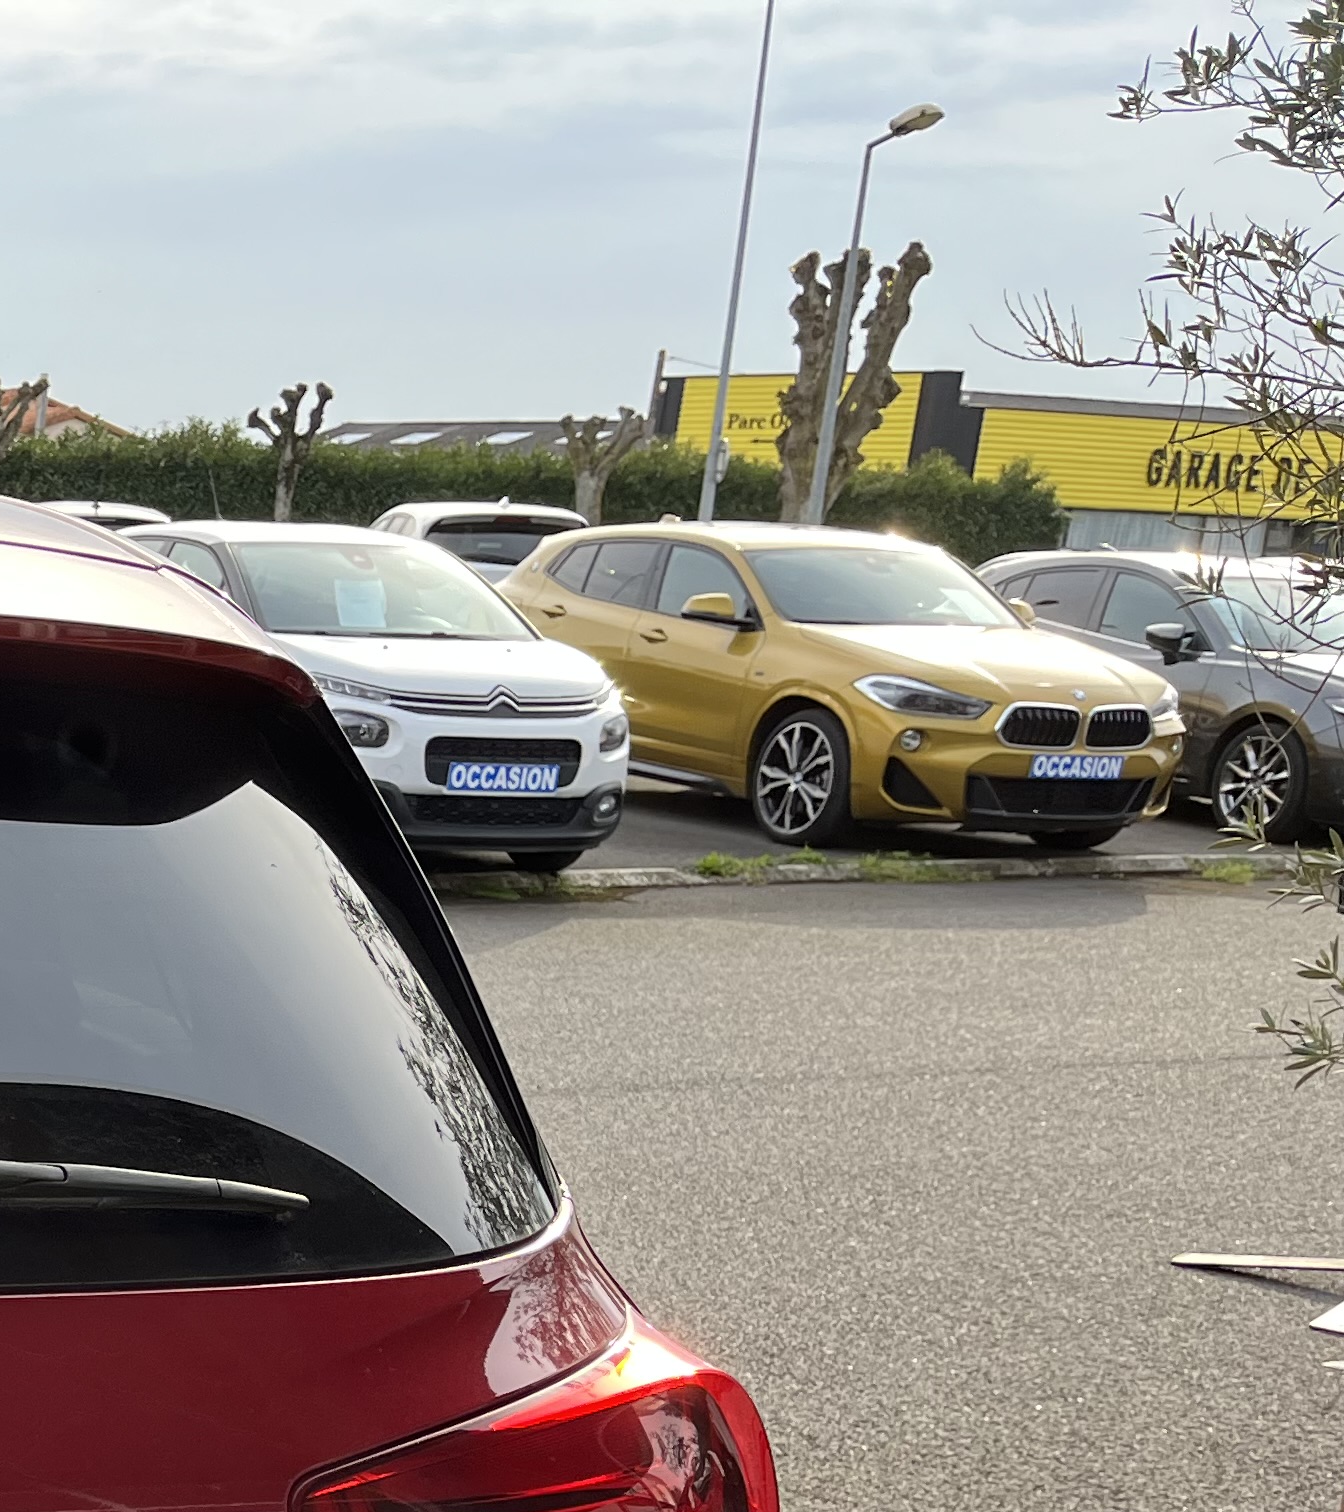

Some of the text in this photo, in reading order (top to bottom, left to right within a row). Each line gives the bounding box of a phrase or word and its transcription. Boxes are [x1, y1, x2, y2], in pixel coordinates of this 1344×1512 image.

[727, 413, 763, 430] Parc
[1147, 448, 1262, 493] GARAGE
[451, 764, 557, 790] OCCASION
[1033, 755, 1123, 779] OCCASION
